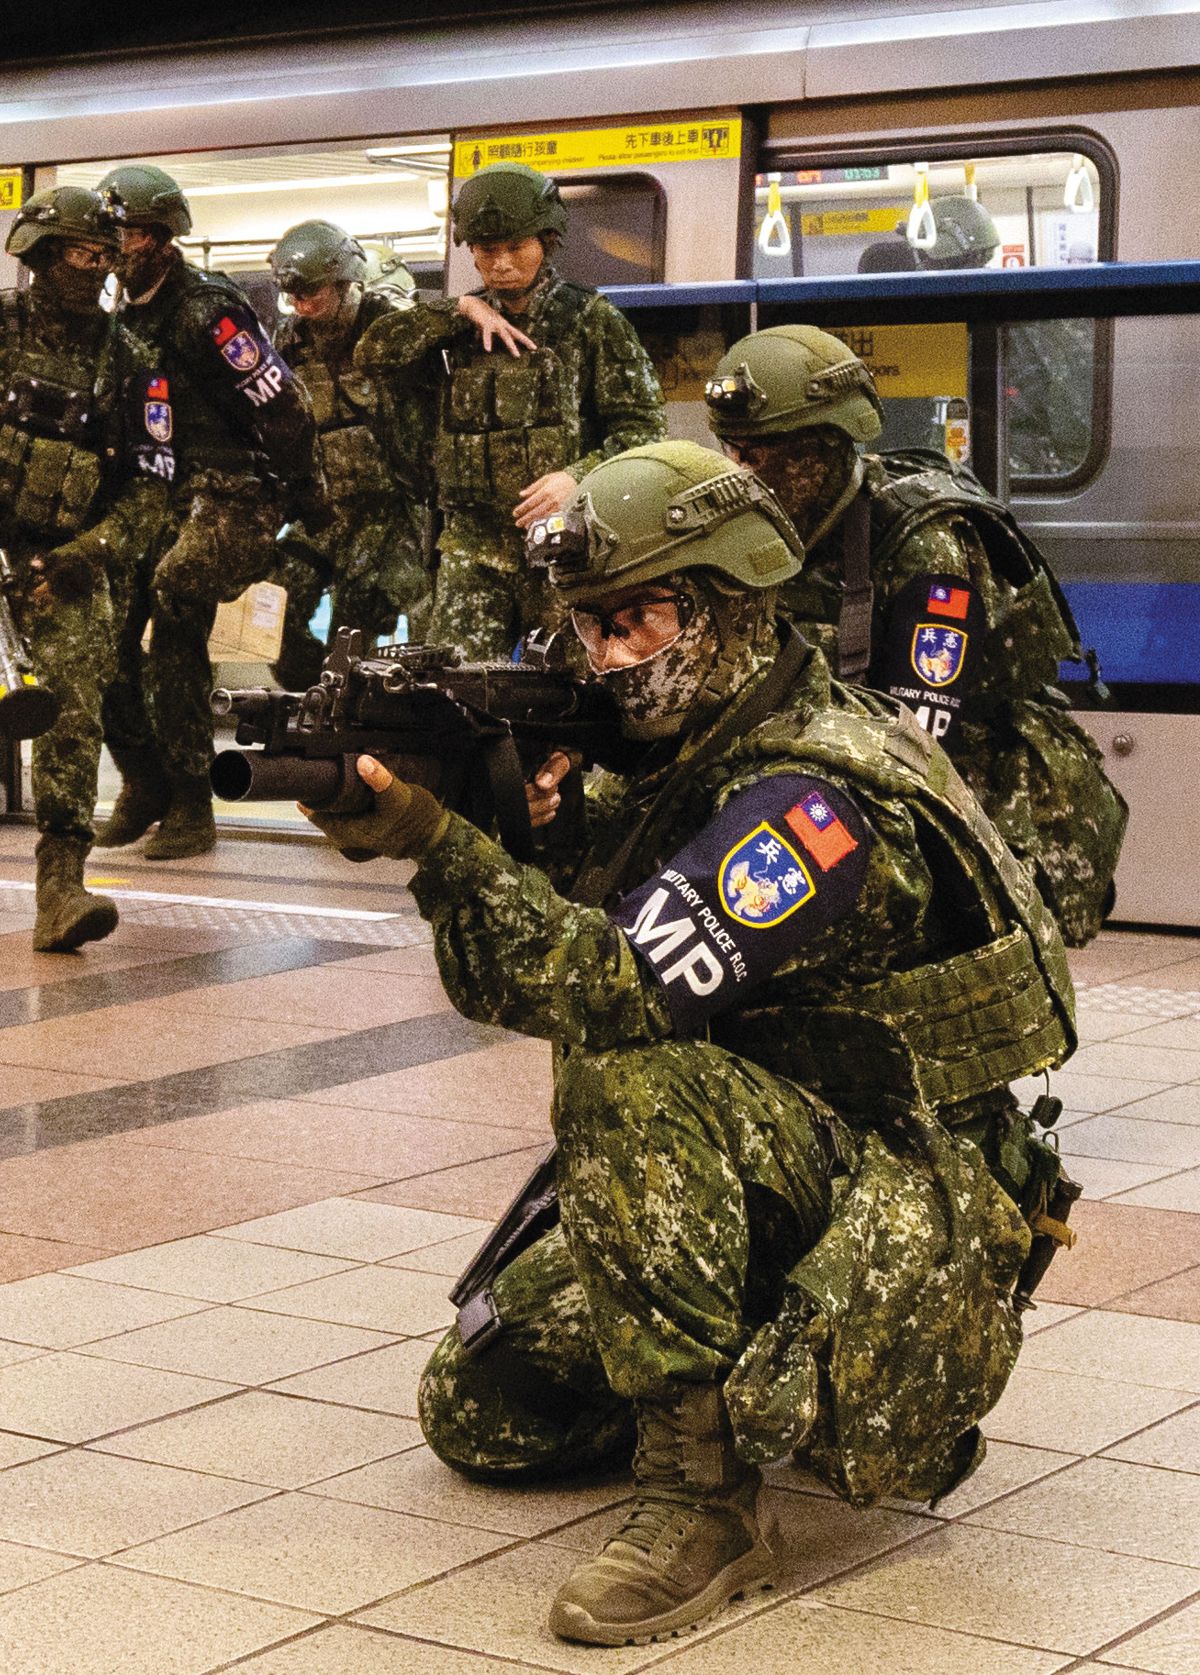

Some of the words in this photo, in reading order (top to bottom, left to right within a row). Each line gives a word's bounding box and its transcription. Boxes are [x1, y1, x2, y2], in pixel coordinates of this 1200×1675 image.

[625, 129, 699, 149] 先下車後上車
[243, 365, 282, 407] MP
[867, 363, 900, 376] oors
[622, 887, 724, 996] MP
[697, 906, 736, 954] POLICE
